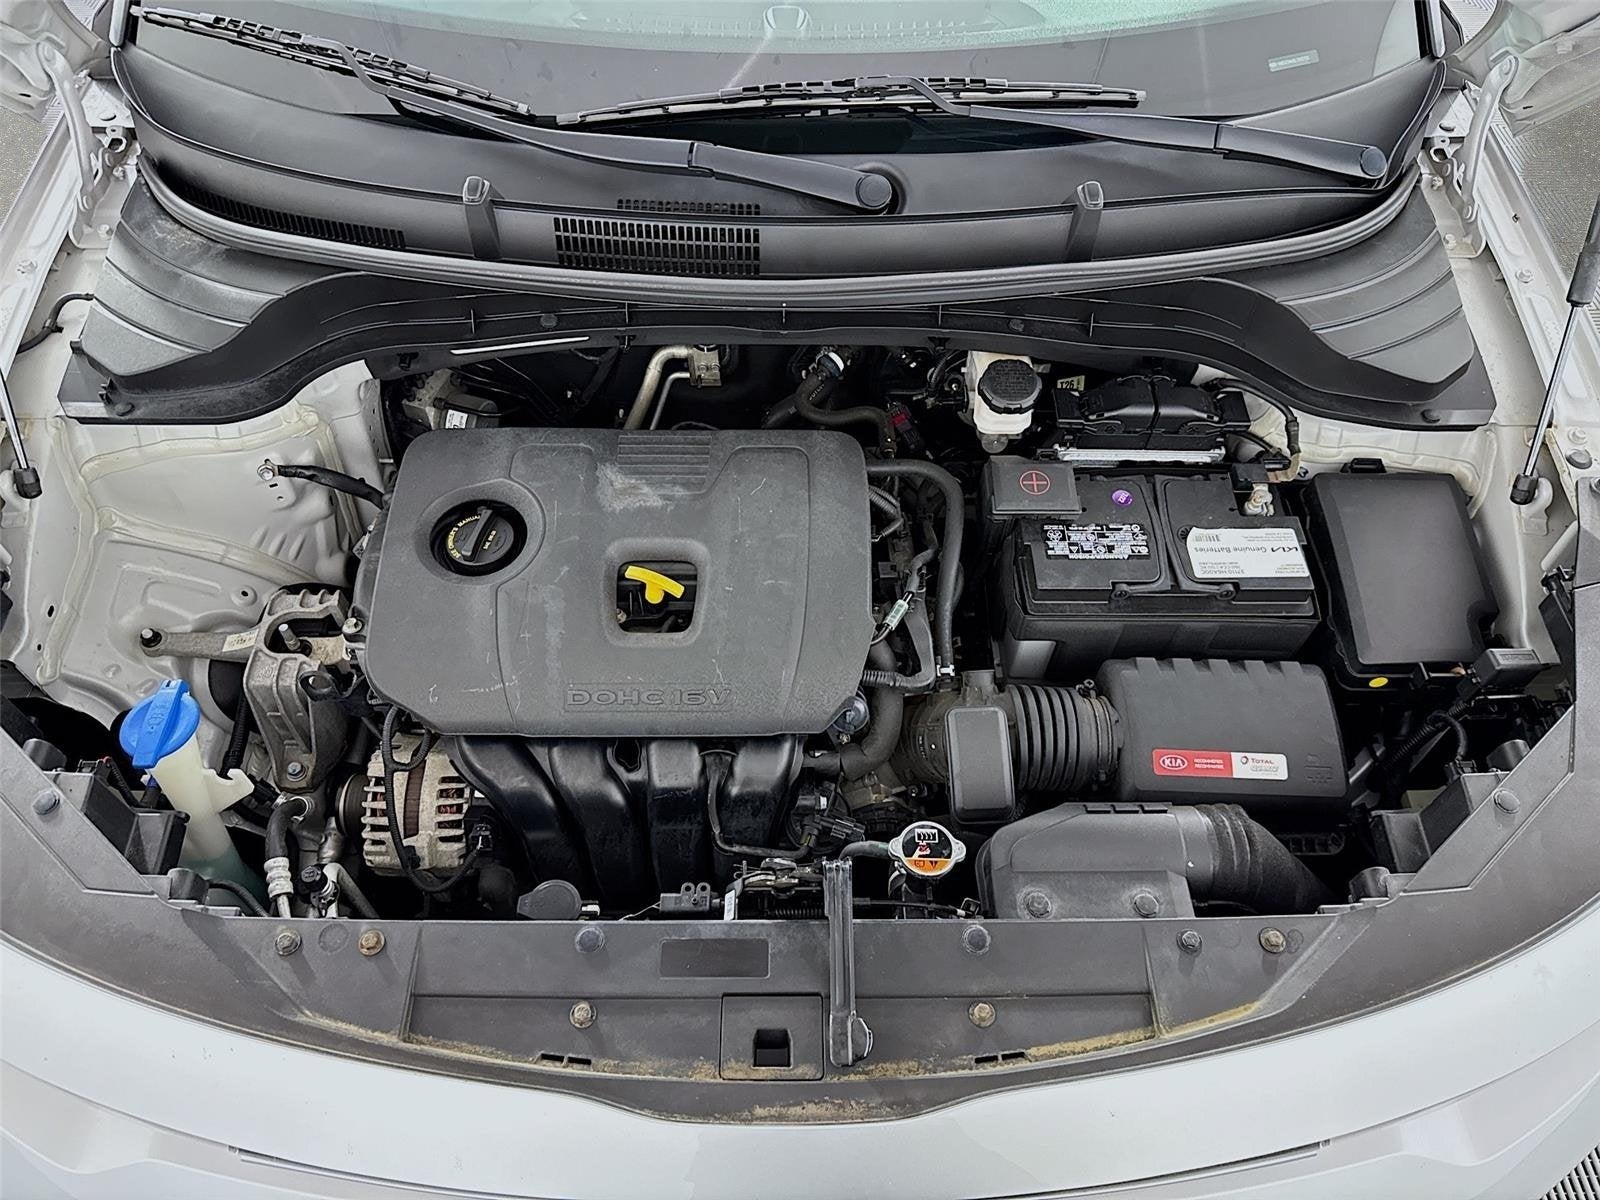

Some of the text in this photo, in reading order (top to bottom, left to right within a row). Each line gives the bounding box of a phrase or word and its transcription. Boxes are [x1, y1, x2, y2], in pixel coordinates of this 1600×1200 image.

[567, 689, 731, 706] DOHC 16V
[1163, 757, 1184, 768] KIA
[1251, 757, 1275, 765] TOTAL
